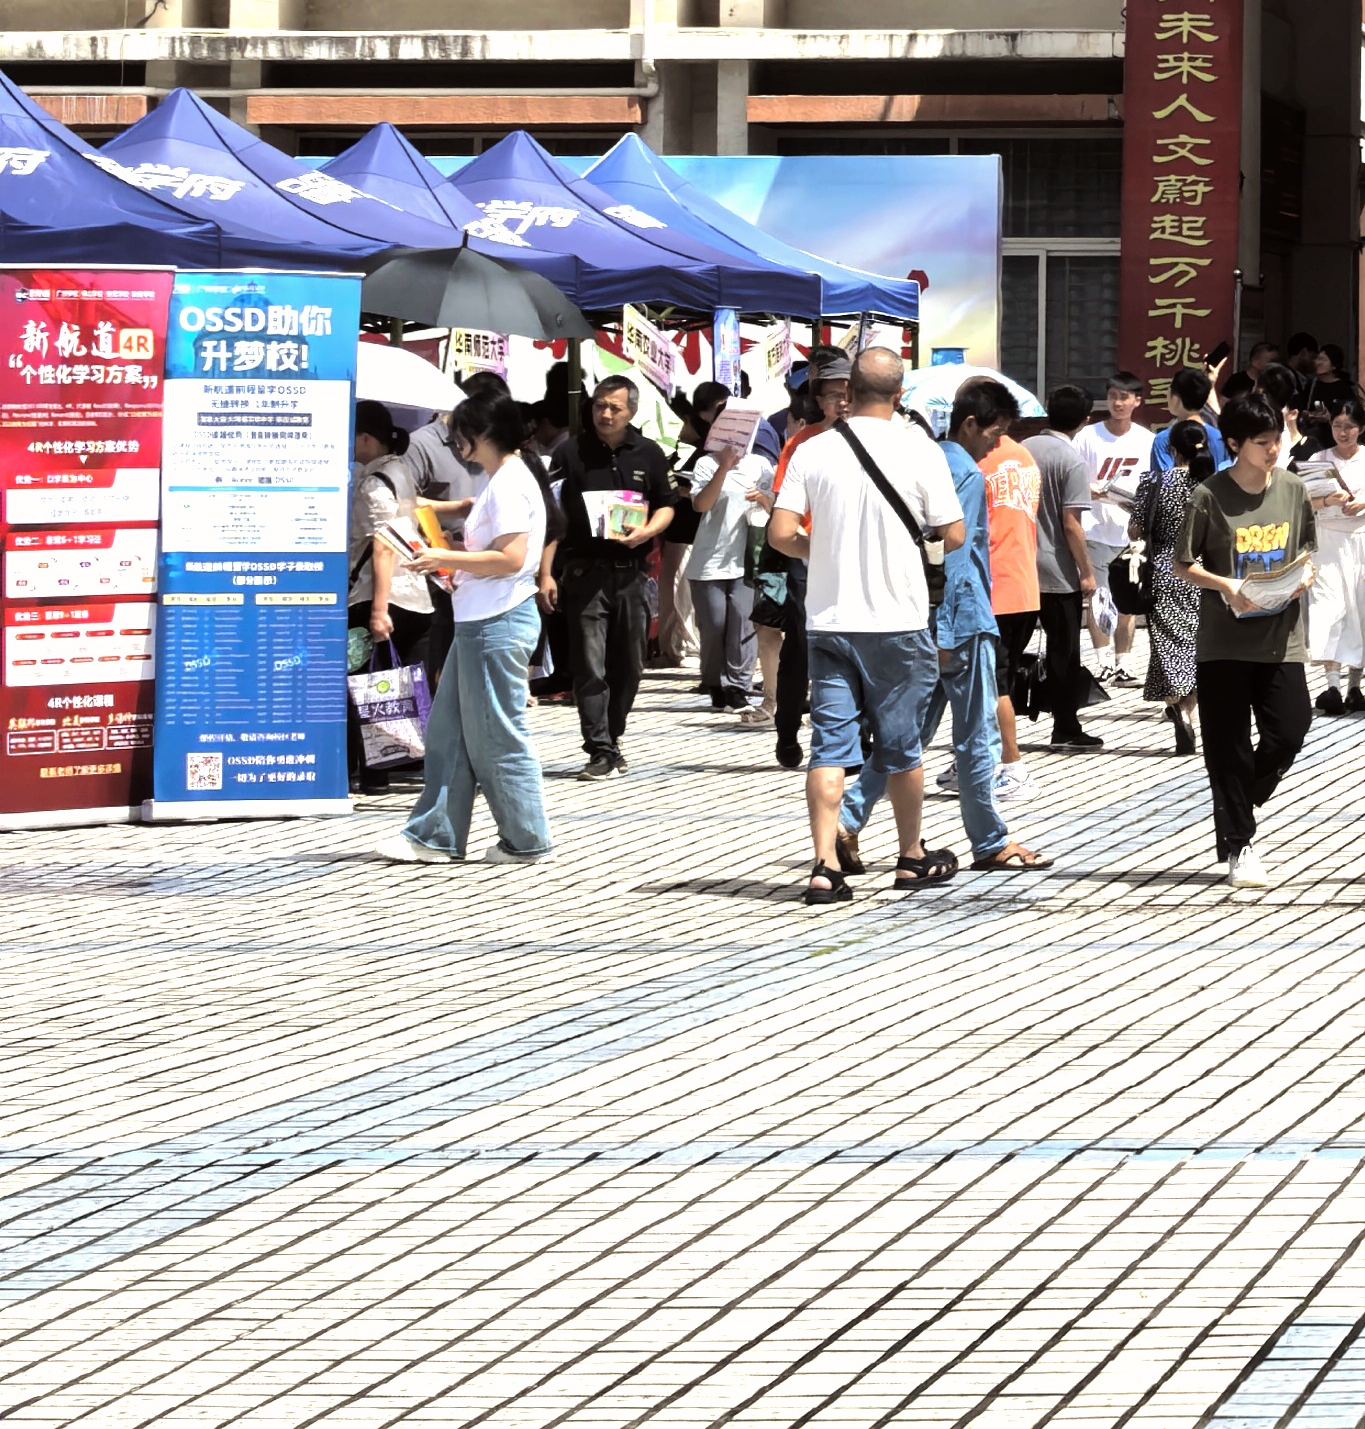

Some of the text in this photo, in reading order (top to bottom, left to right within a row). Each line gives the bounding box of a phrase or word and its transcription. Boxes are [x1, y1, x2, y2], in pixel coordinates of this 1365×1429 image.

[179, 305, 333, 336] OSSD助你
[19, 320, 150, 359] 新航道 4R
